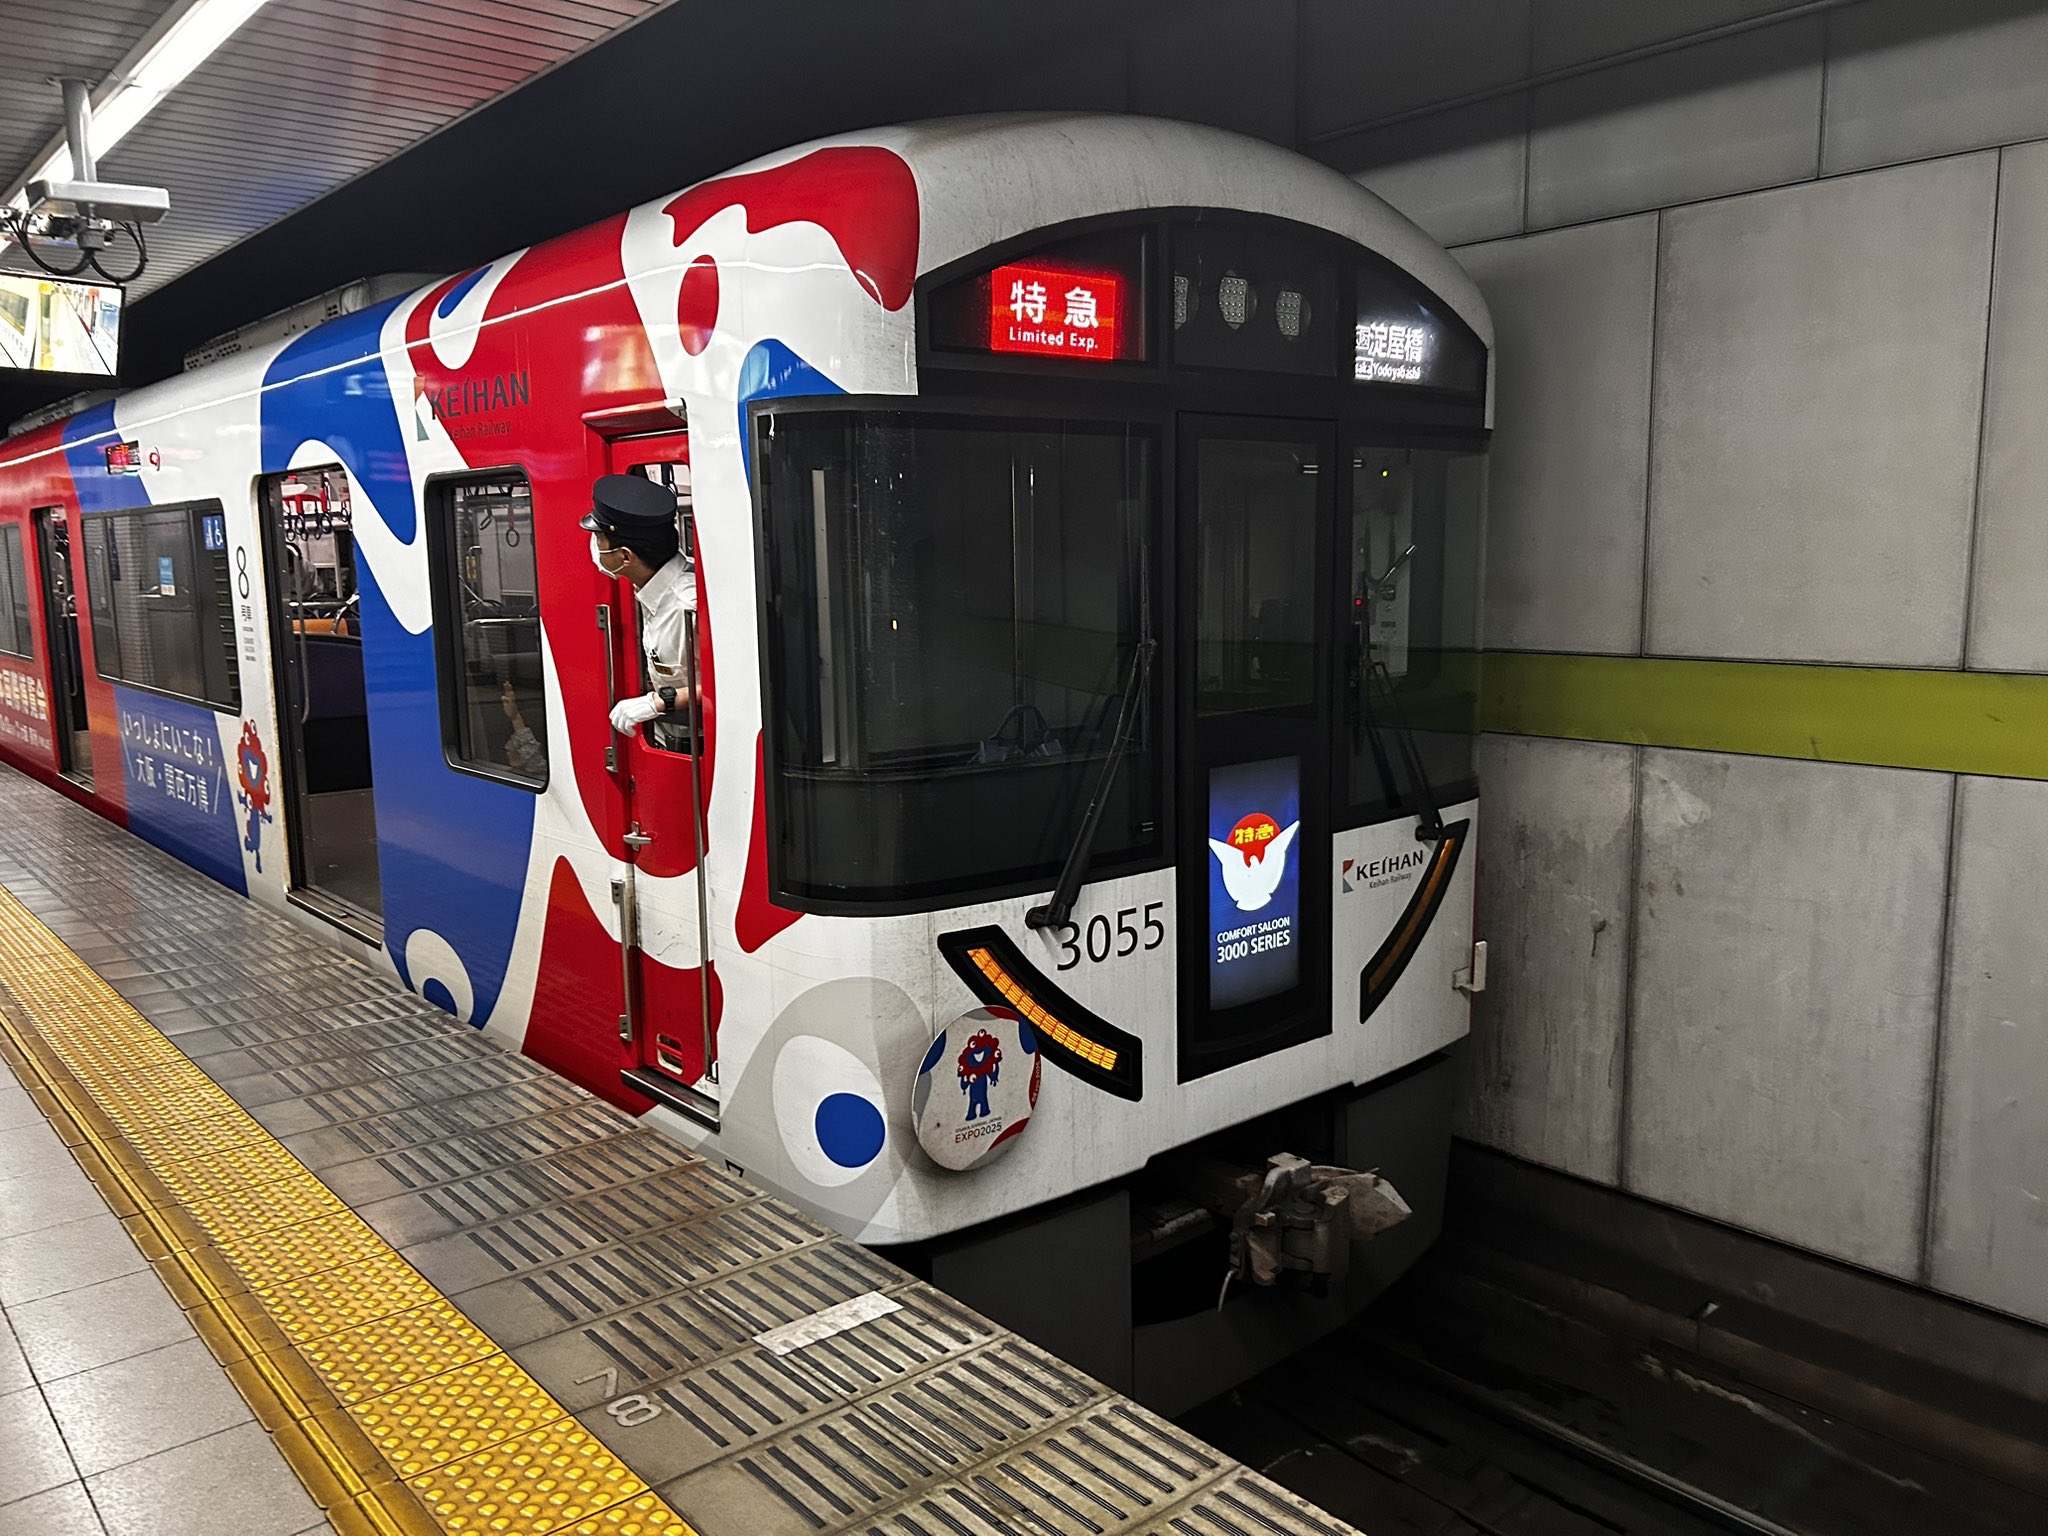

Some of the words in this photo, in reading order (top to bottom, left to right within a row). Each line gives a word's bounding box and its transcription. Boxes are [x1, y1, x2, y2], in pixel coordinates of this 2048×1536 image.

[1009, 279, 1099, 329] 特急
[1009, 326, 1064, 346] Limited
[1069, 332, 1098, 352] Exp.
[430, 370, 529, 420] KEIHAN
[1235, 824, 1275, 845] 特急
[1356, 850, 1423, 881] KEIHAN
[1057, 901, 1164, 971] 3055
[1217, 925, 1257, 944] COMFORT
[1258, 916, 1290, 935] SALOON
[1217, 941, 1248, 963] 3000
[1251, 930, 1290, 955] SERIES
[955, 1122, 1002, 1143] EXPO2025
